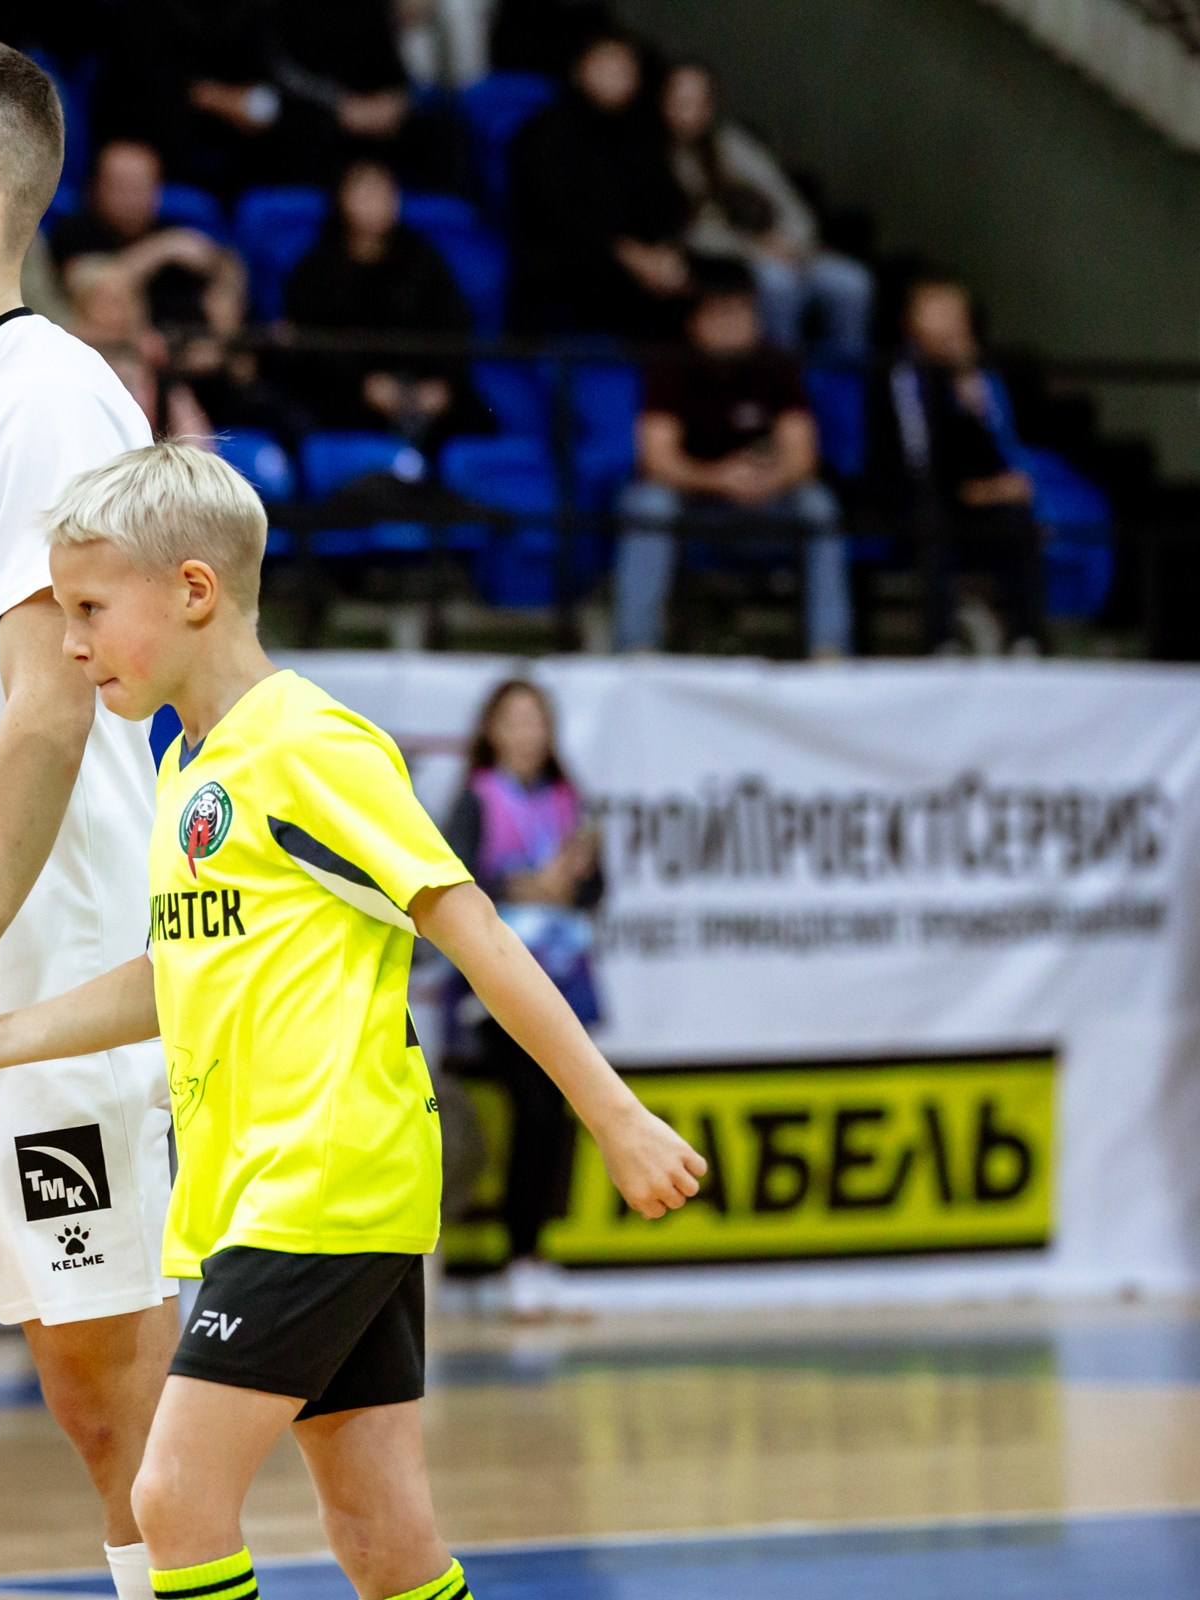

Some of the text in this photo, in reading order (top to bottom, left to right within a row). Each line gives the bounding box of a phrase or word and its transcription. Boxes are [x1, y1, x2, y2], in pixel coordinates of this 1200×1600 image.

[616, 1092, 1034, 1218] АБЕЛЬ
[24, 1169, 86, 1208] ТМК
[51, 1254, 105, 1272] KELME
